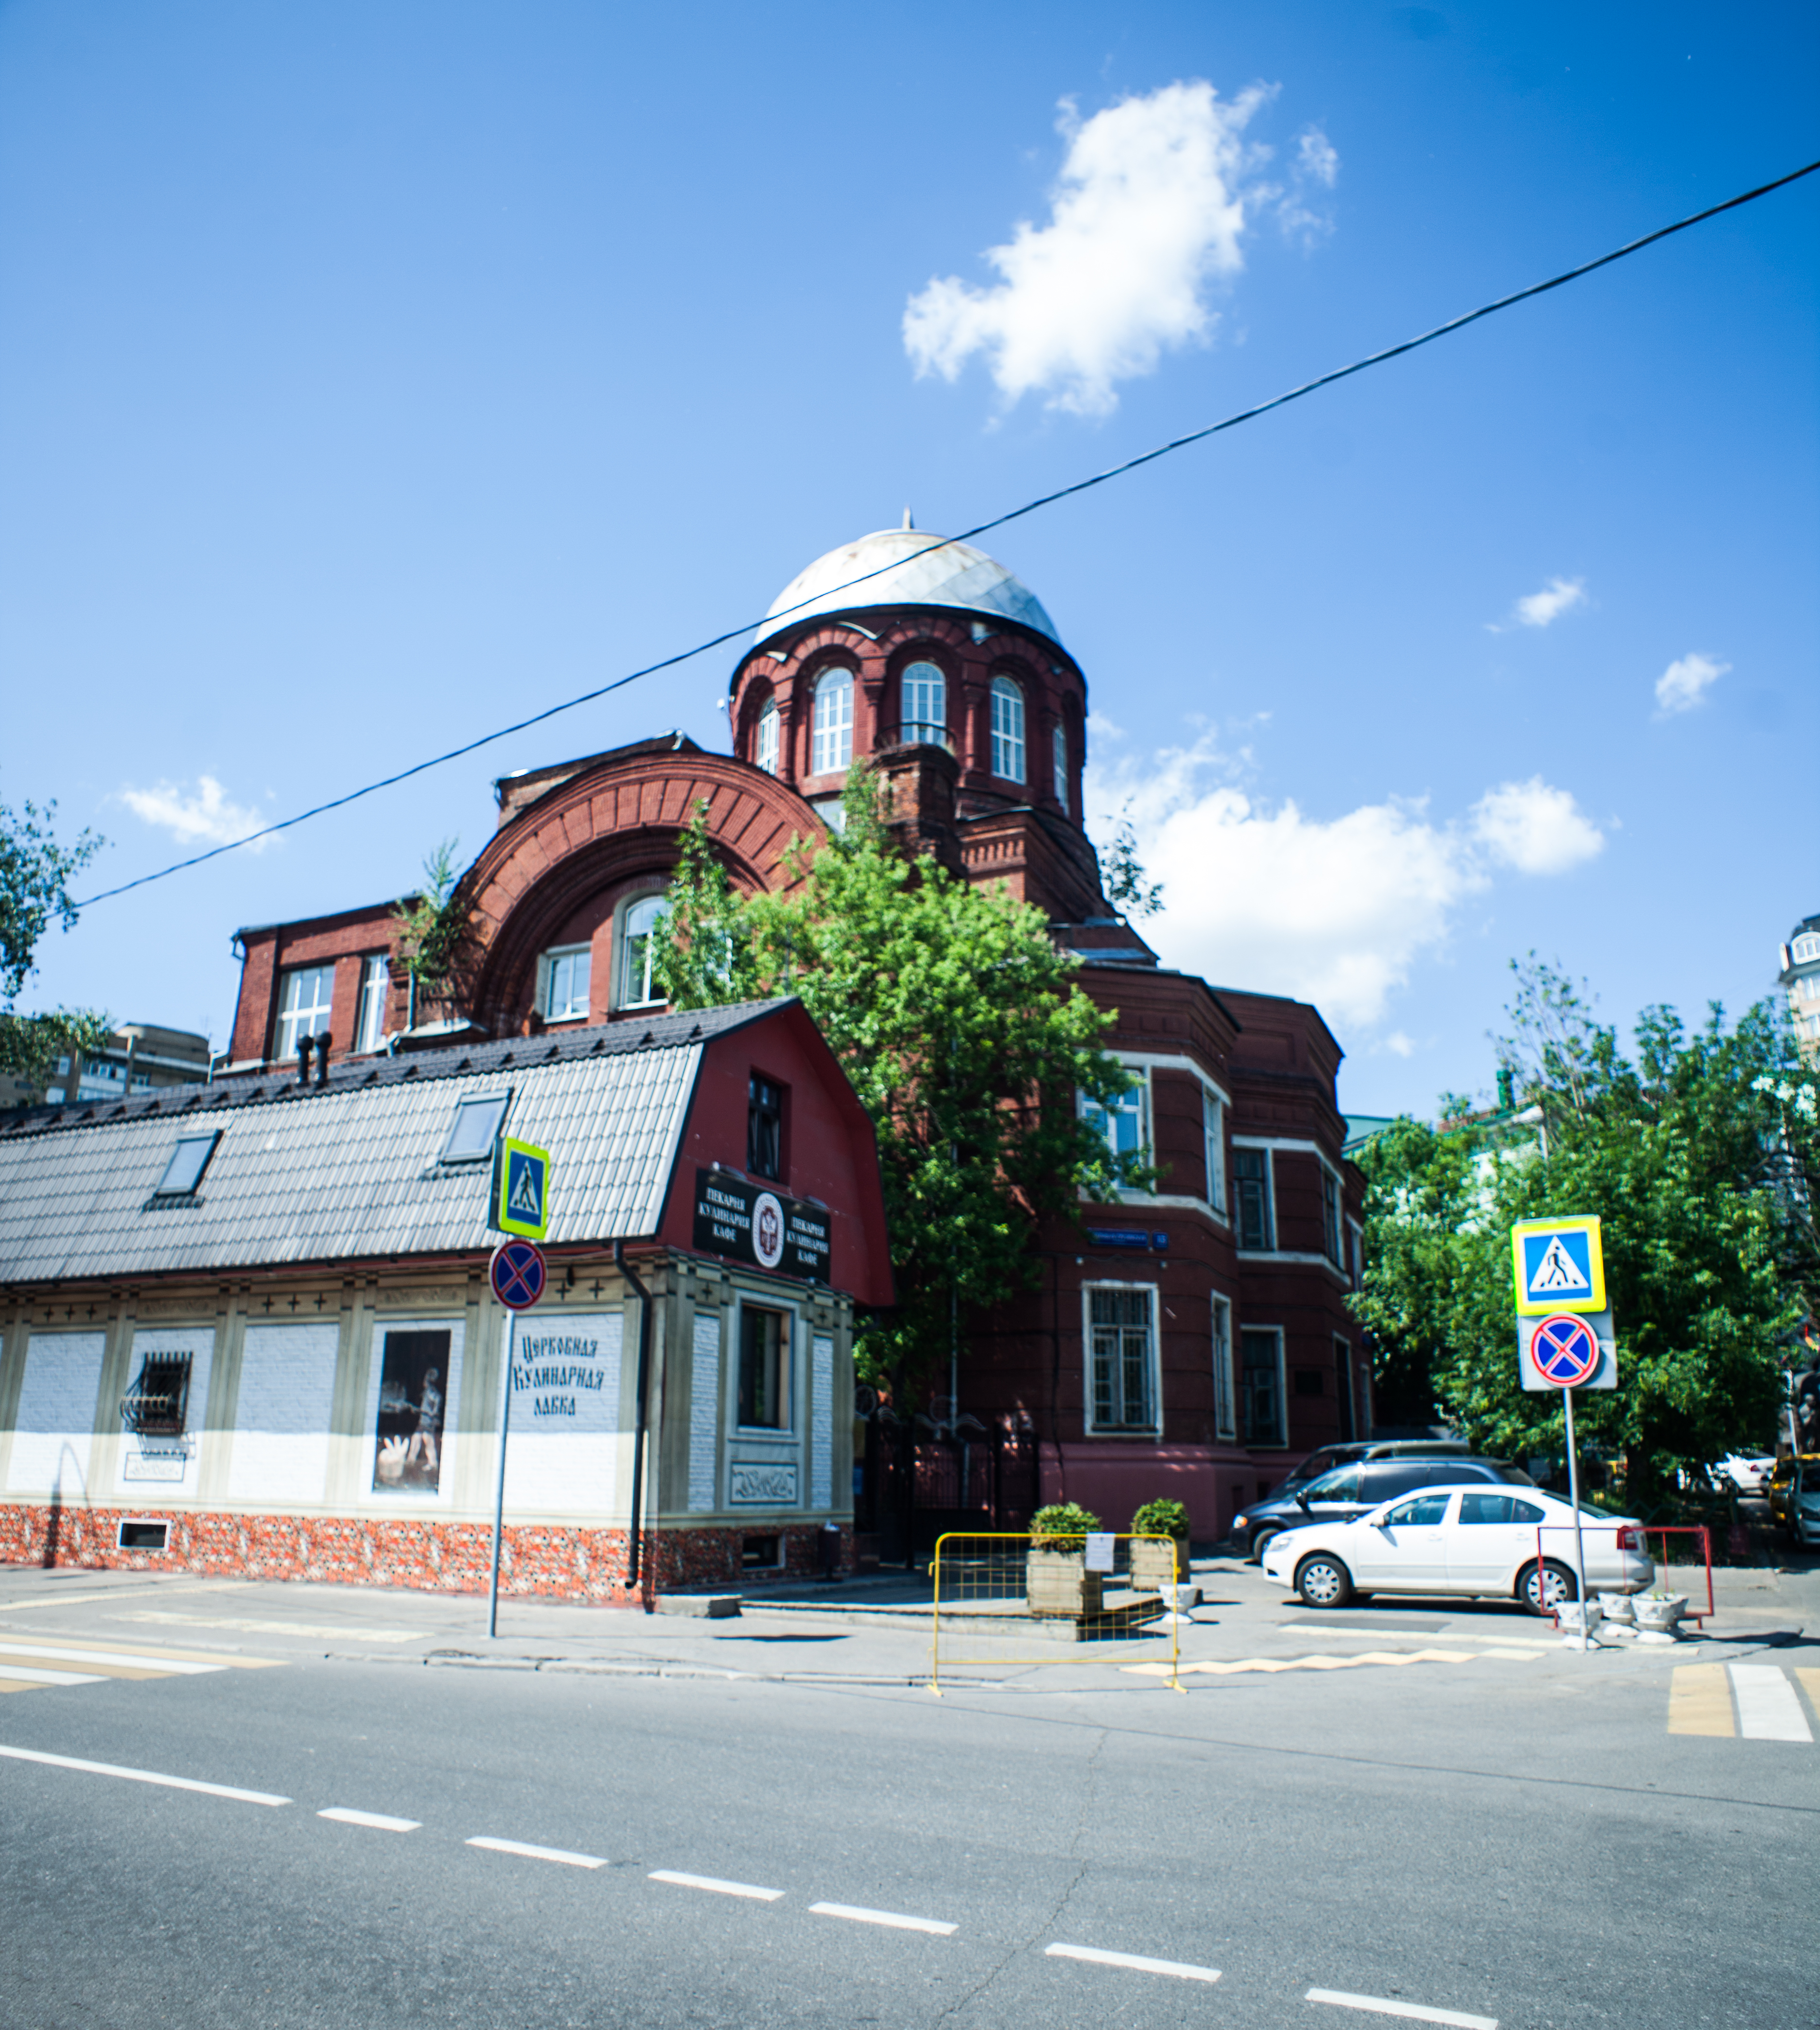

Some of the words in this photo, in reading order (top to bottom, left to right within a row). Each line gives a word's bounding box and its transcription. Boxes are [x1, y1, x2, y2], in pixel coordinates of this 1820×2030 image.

[706, 1187, 745, 1211] ПЕКАРНЯ
[698, 1202, 750, 1230] КУЛИНАРИЯ
[791, 1216, 825, 1237] ПЕКАРНЯ
[713, 1223, 736, 1242] КАФЕ
[786, 1230, 829, 1254] КУЛИНАРИЯ
[797, 1249, 818, 1267] КАФЕ
